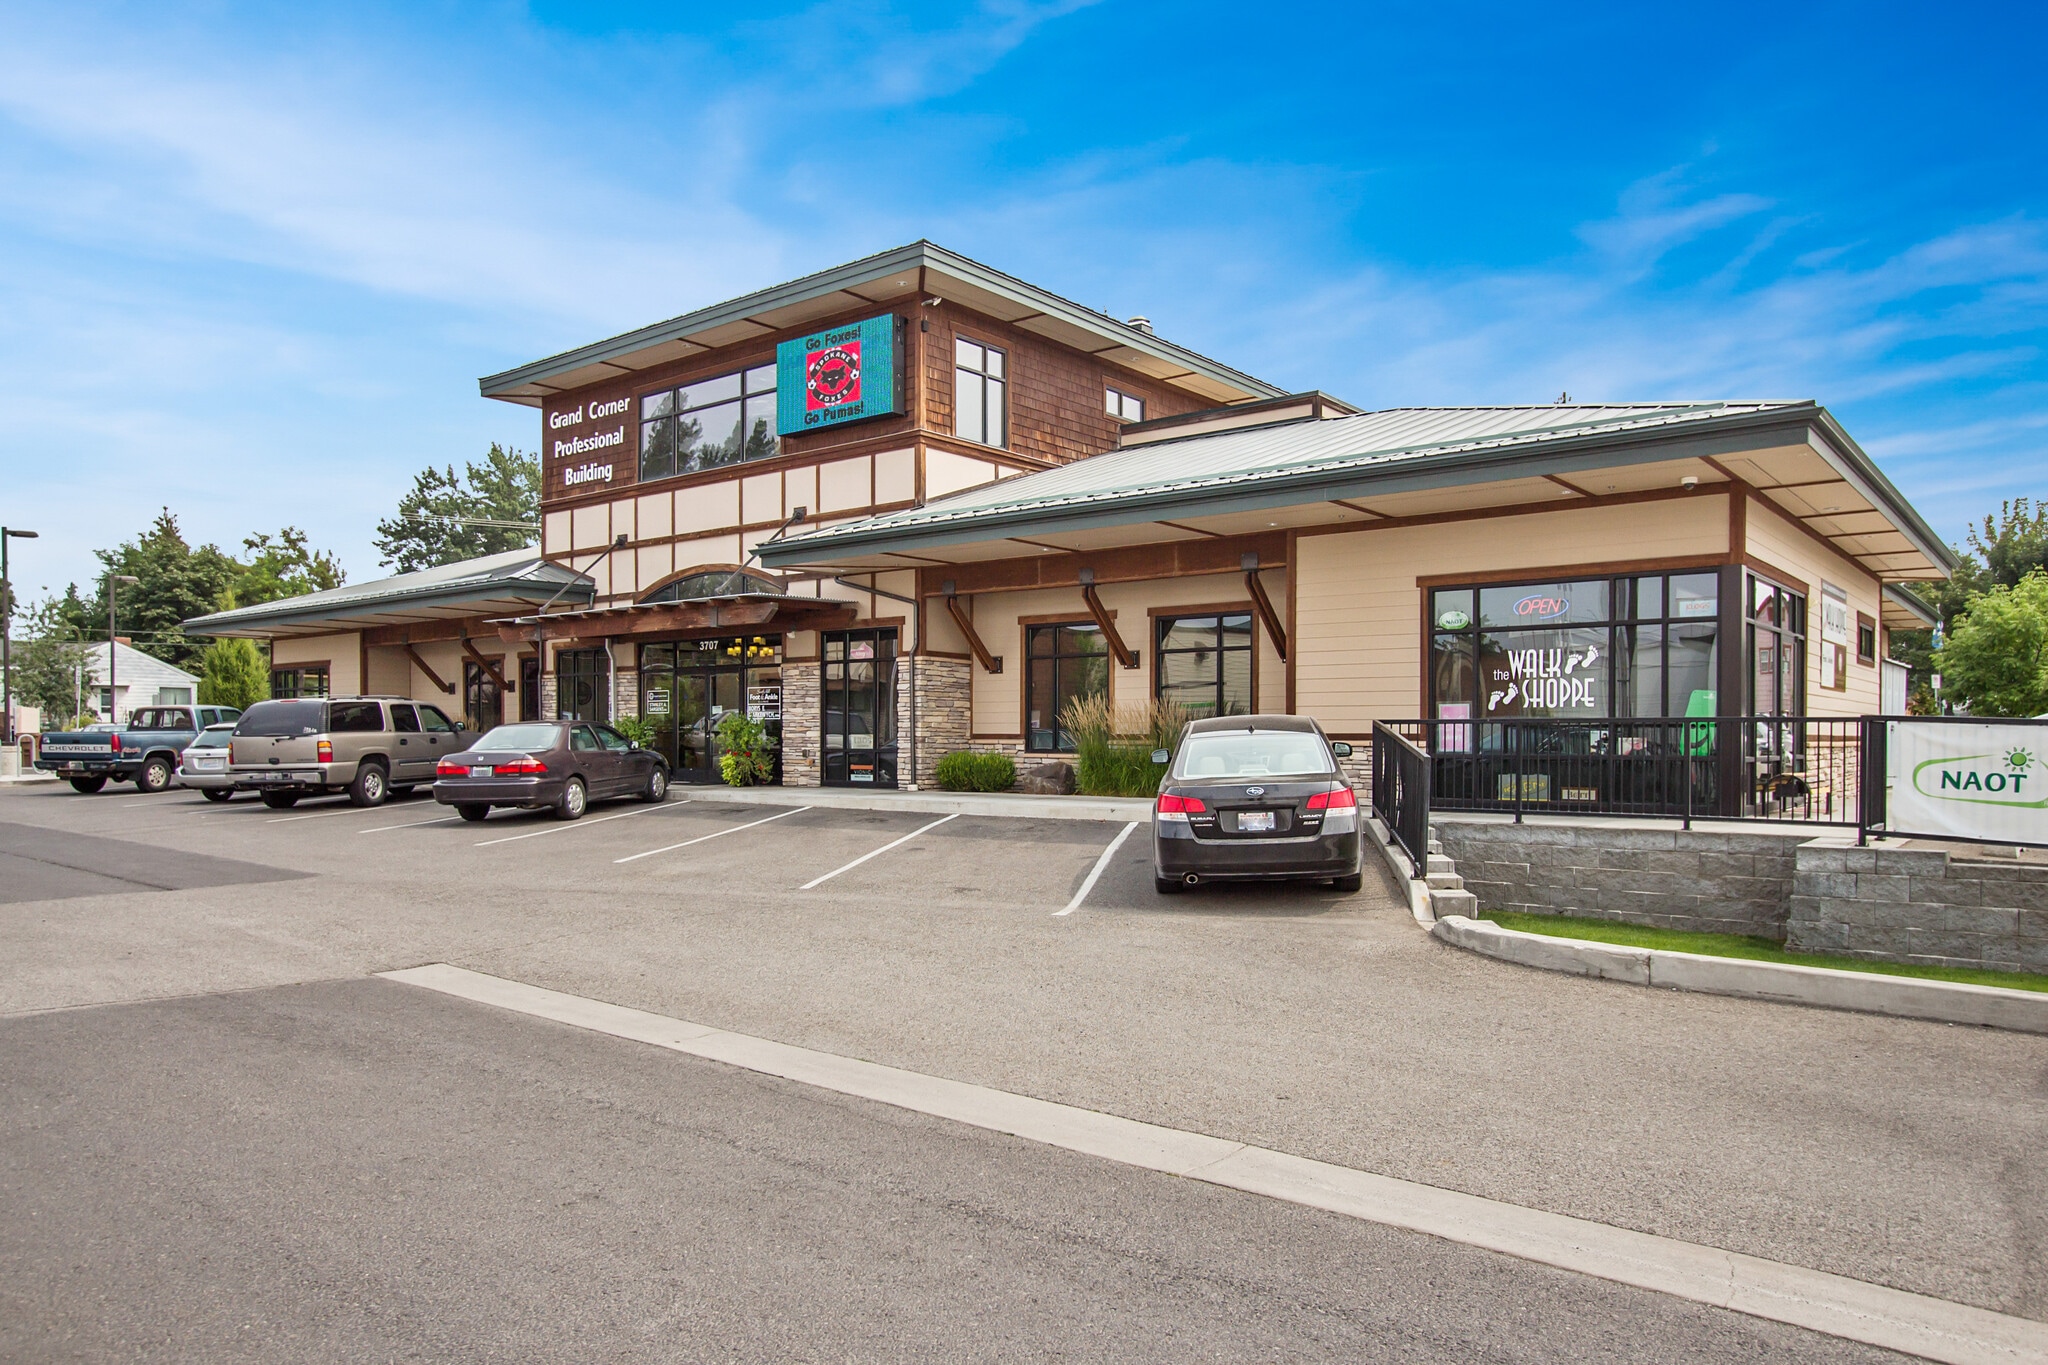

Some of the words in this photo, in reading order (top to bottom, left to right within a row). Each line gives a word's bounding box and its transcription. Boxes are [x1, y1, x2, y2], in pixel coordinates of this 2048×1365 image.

[805, 338, 821, 350] Go
[825, 326, 861, 346] Foxes!
[815, 351, 851, 371] SPOKANE
[819, 389, 848, 402] FOXES
[549, 405, 583, 430] Grand
[588, 397, 631, 420] Corner
[804, 412, 820, 425] Go
[823, 401, 864, 421] Pumas!
[554, 425, 624, 459] Professional
[565, 462, 613, 486] Building
[1518, 597, 1562, 616] OPEN
[1445, 618, 1463, 626] NAOT
[699, 640, 719, 651] 3707
[1493, 669, 1510, 681] the
[1507, 648, 1562, 680] WALK
[1521, 677, 1595, 709] SHOPPE
[1941, 770, 2028, 794] NAOT
